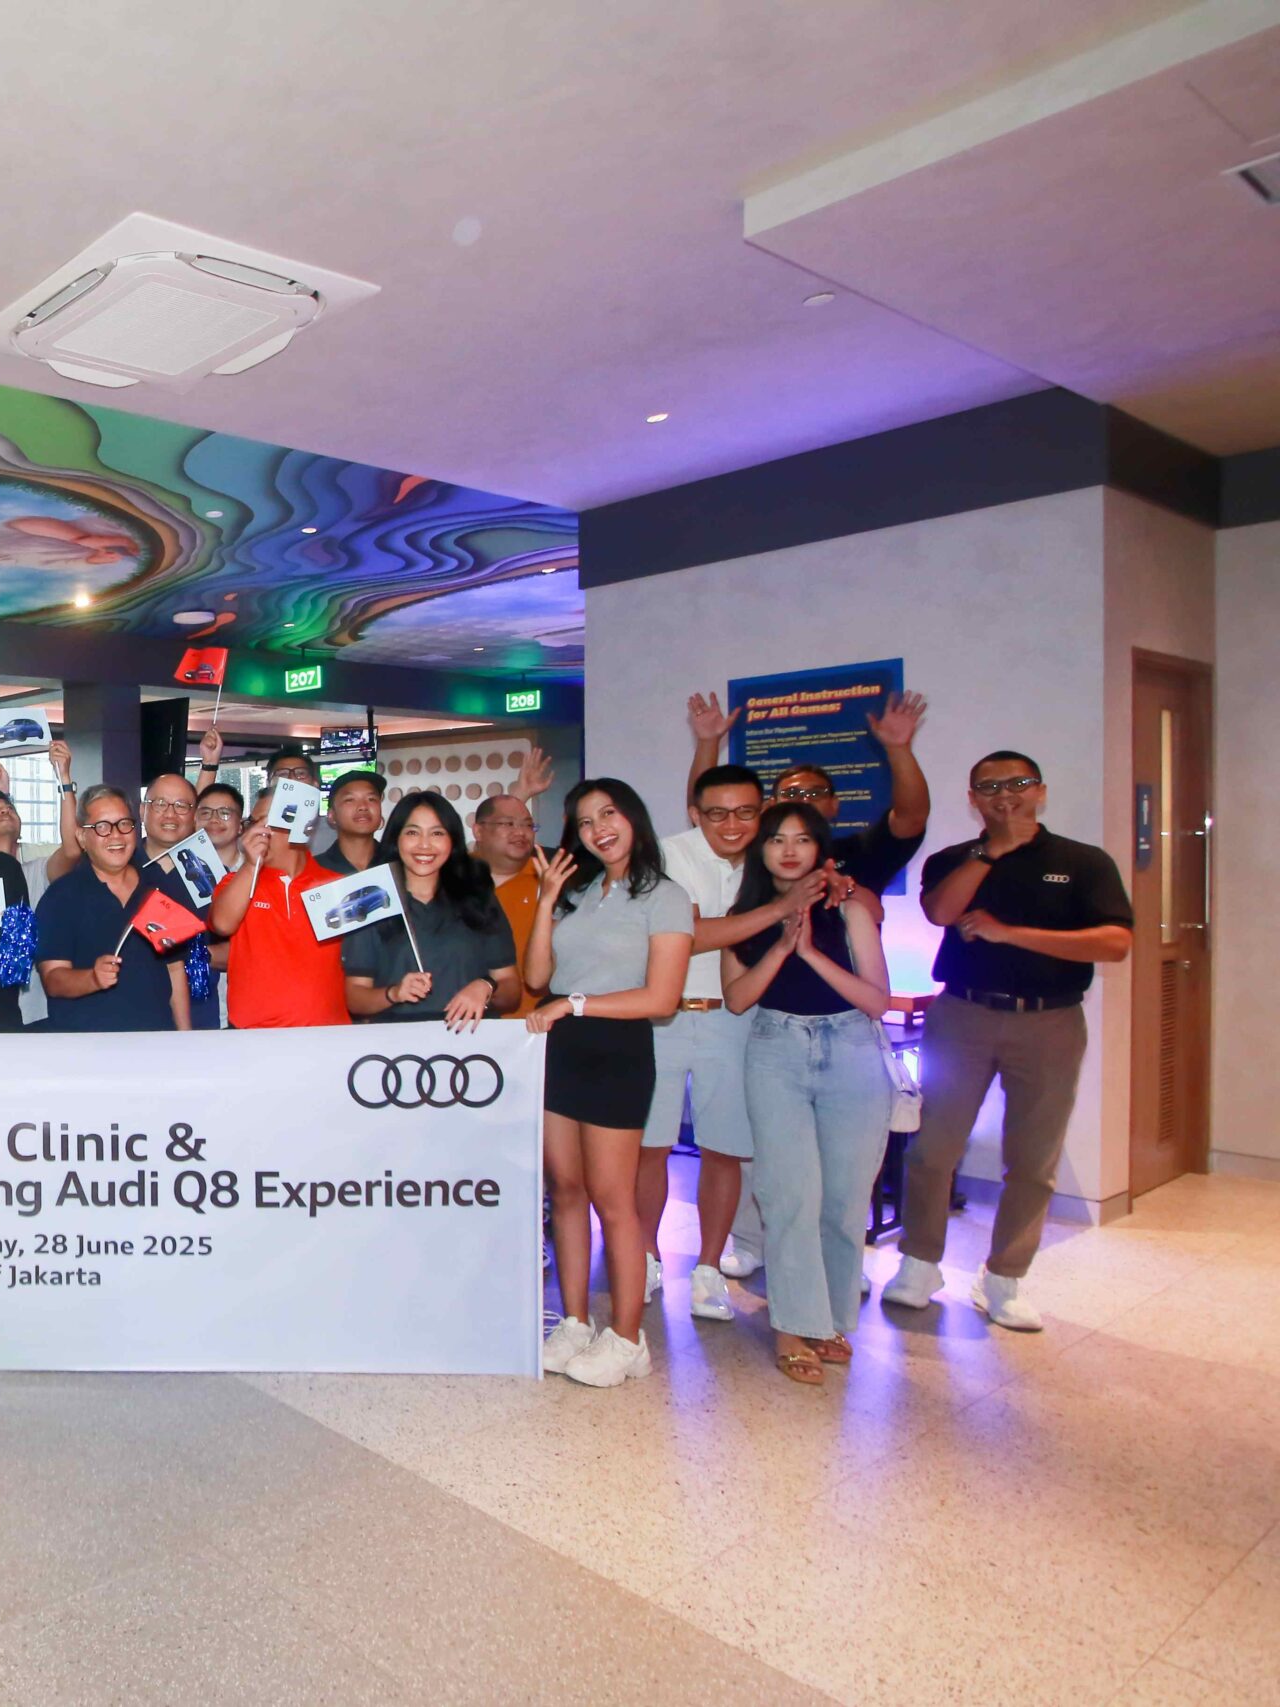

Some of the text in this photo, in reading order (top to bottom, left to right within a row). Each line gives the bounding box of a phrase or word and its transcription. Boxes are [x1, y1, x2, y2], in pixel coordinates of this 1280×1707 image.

[290, 670, 315, 688] 207
[511, 694, 535, 708] 208
[746, 685, 881, 708] General Instruction
[747, 702, 842, 722] for All Games:
[282, 782, 295, 791] Q8
[304, 799, 316, 807] Q8
[198, 834, 207, 845] Q8
[308, 892, 322, 902] Q8
[7, 1121, 148, 1161] Clinic
[165, 1122, 207, 1161] &
[55, 1170, 159, 1207] Audi
[173, 1170, 240, 1214] Q8
[255, 1170, 501, 1217] Experience
[34, 1234, 68, 1254] 28
[75, 1234, 134, 1258] June
[143, 1235, 213, 1256] 2025
[7, 1265, 102, 1289] Jakarta
